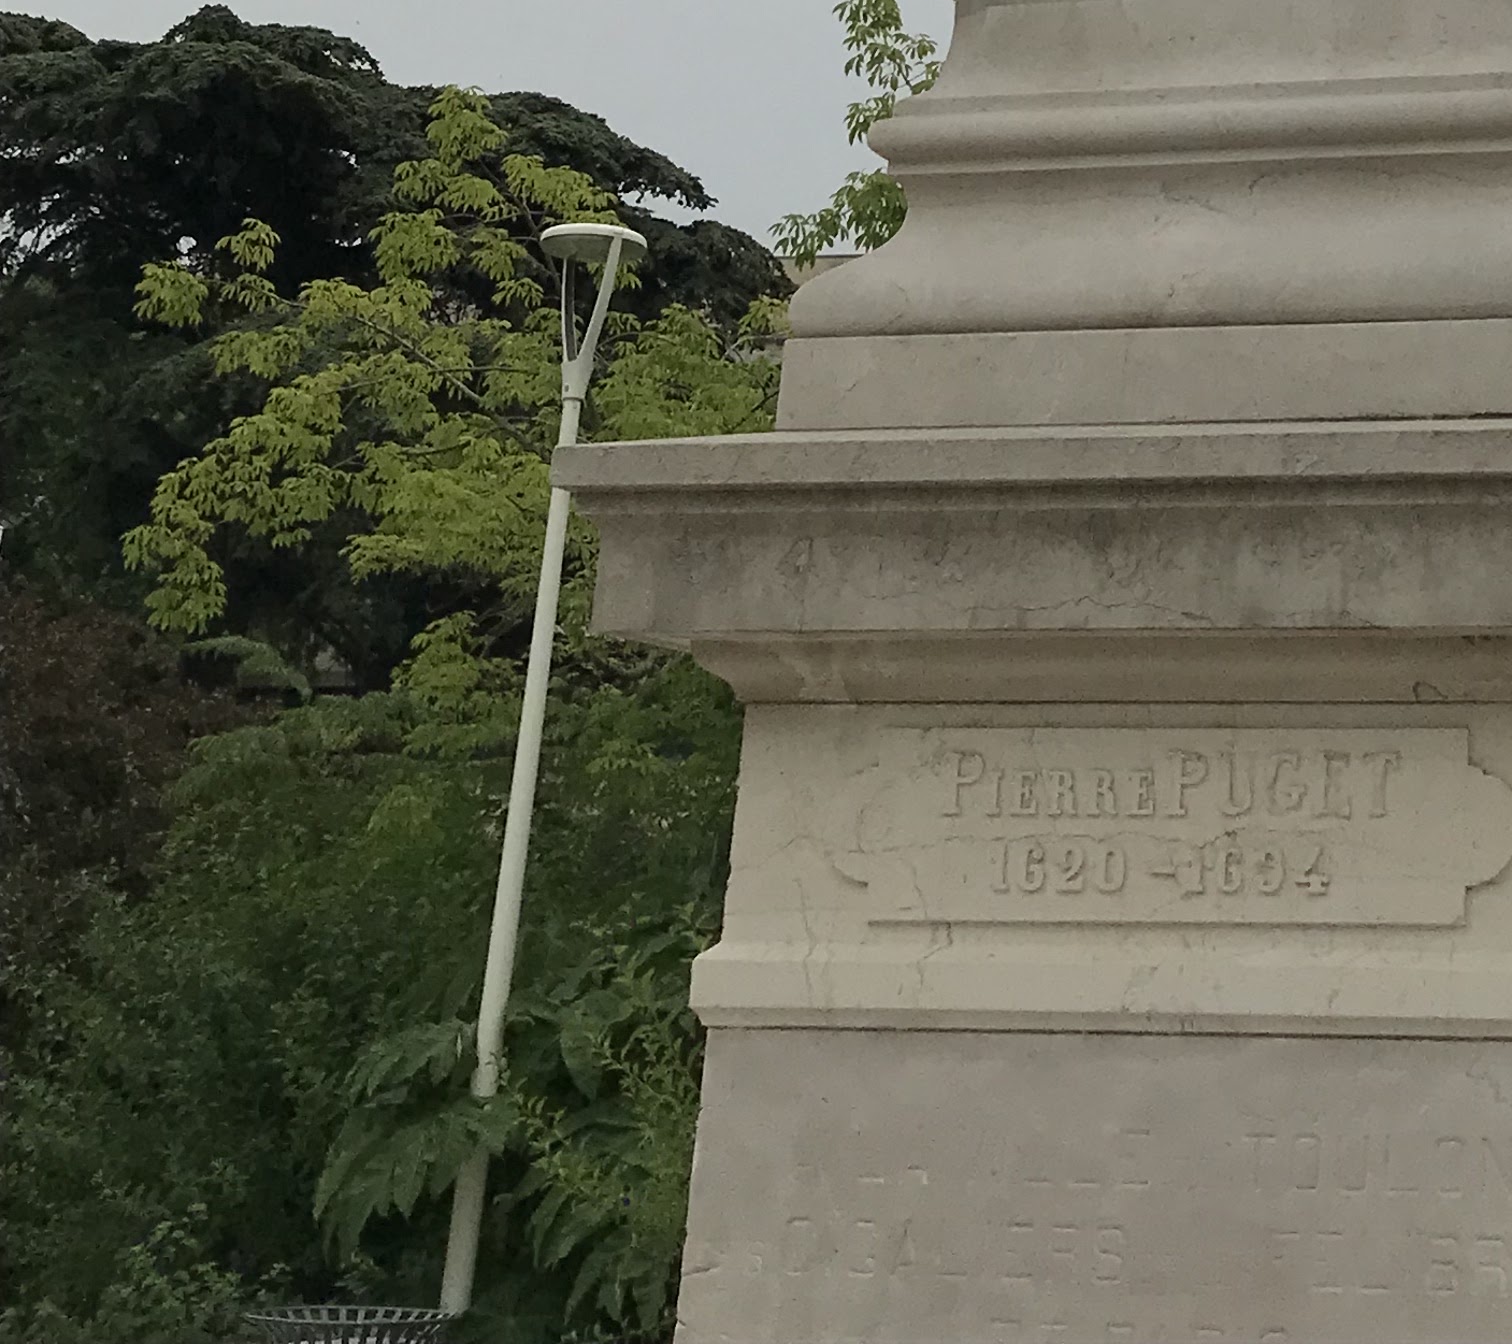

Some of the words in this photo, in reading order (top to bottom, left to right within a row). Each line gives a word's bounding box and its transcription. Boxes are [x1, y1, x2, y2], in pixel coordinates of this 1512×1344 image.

[939, 746, 1157, 819] PIERRE
[1168, 746, 1403, 821] PUGET
[990, 844, 1128, 895] 1620
